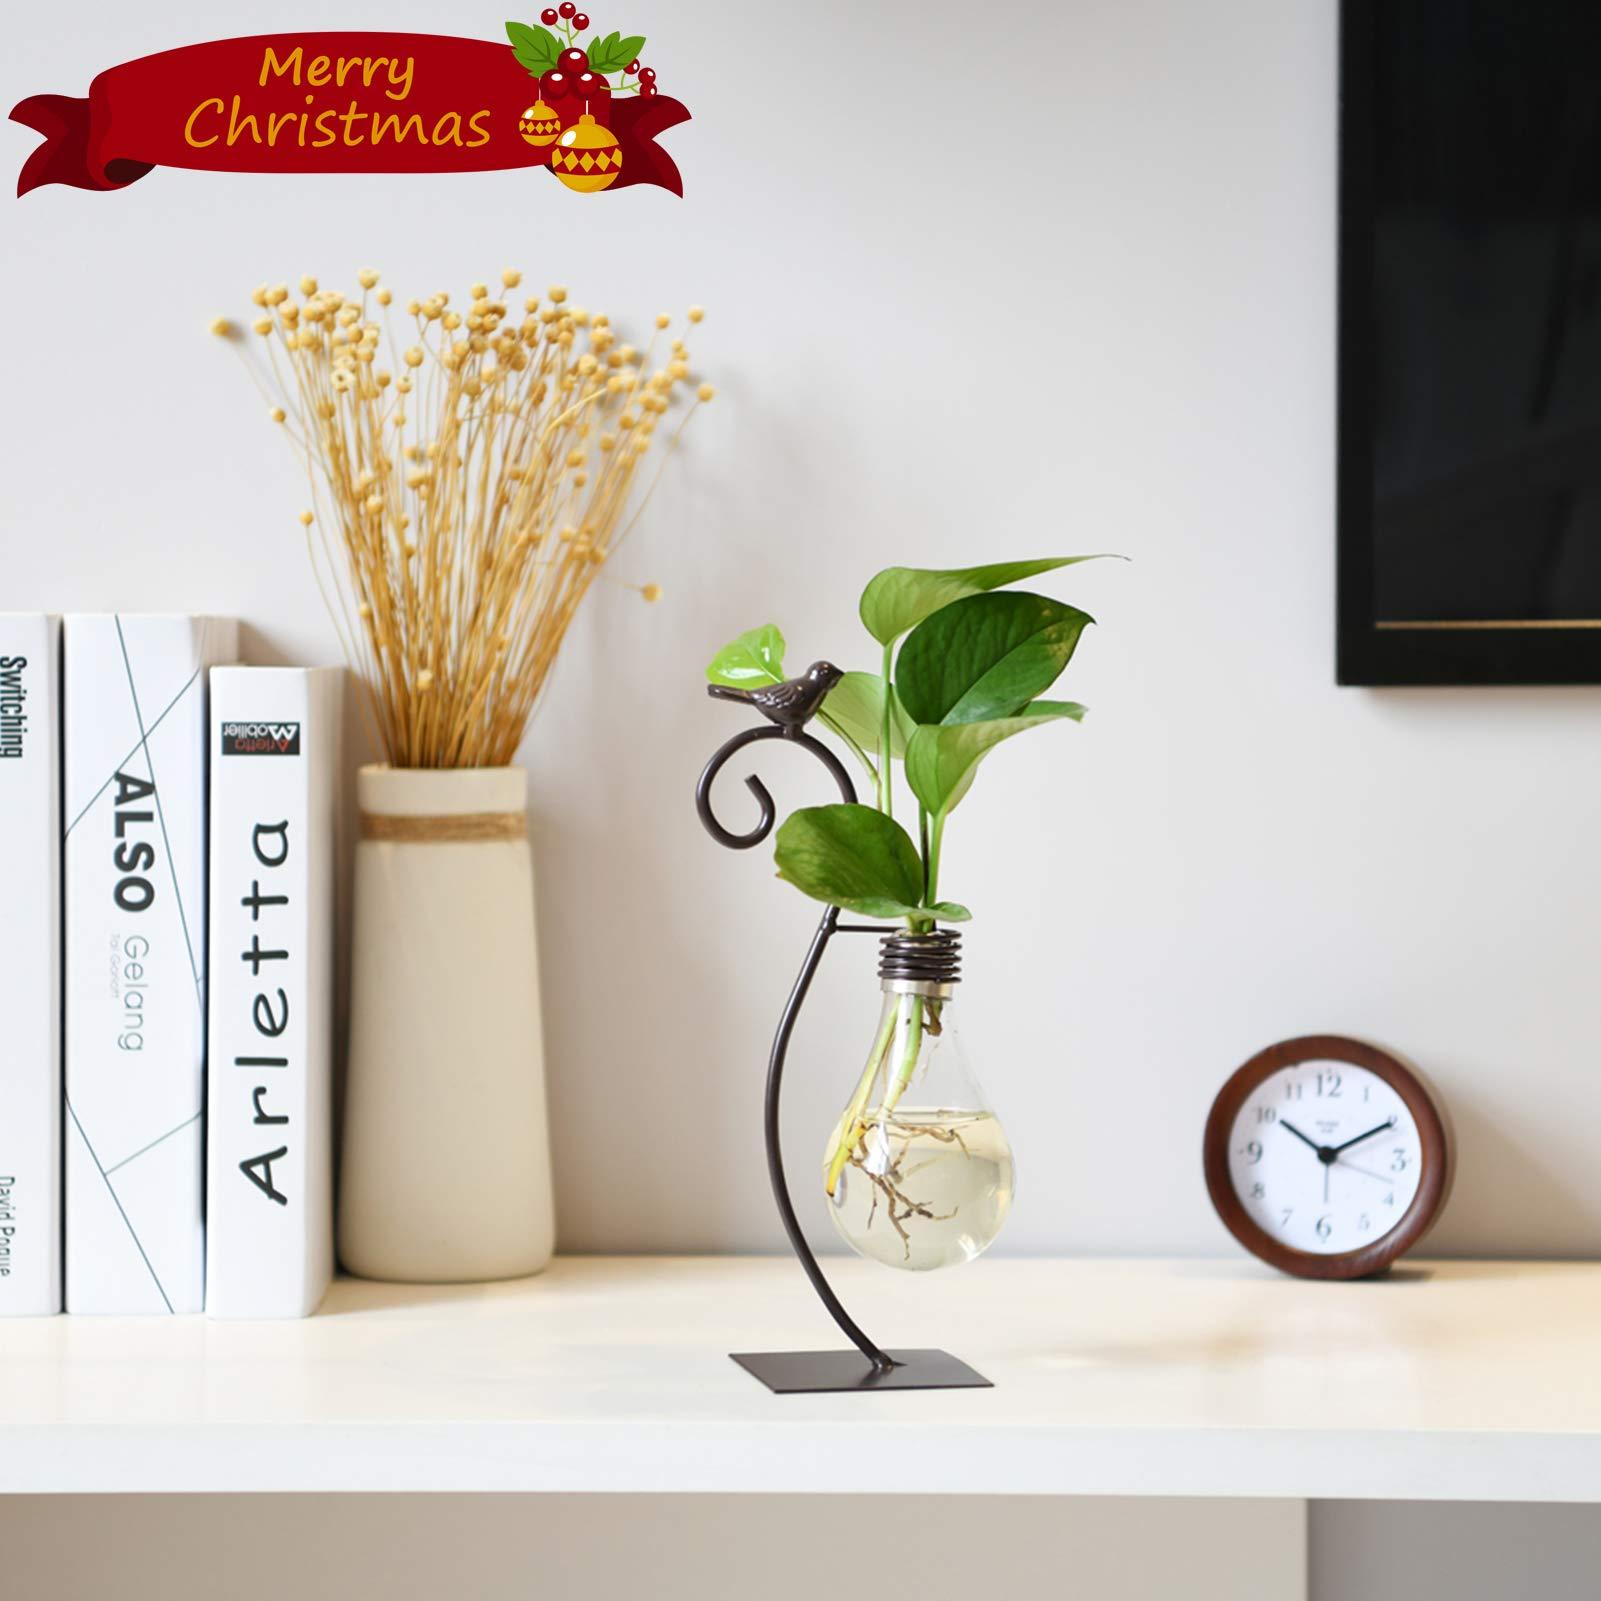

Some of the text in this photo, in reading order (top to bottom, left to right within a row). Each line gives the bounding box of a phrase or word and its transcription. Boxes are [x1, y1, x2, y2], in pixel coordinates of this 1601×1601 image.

[0, 655, 28, 758] Switching
[113, 770, 156, 1052] ALSO Gelang
[235, 819, 289, 1206] Arletta
[1315, 1072, 1341, 1097] 12
[1255, 1107, 1276, 1124] 10
[1247, 1141, 1264, 1165] 9
[1390, 1148, 1407, 1173] 3
[1315, 1214, 1332, 1238] 6
